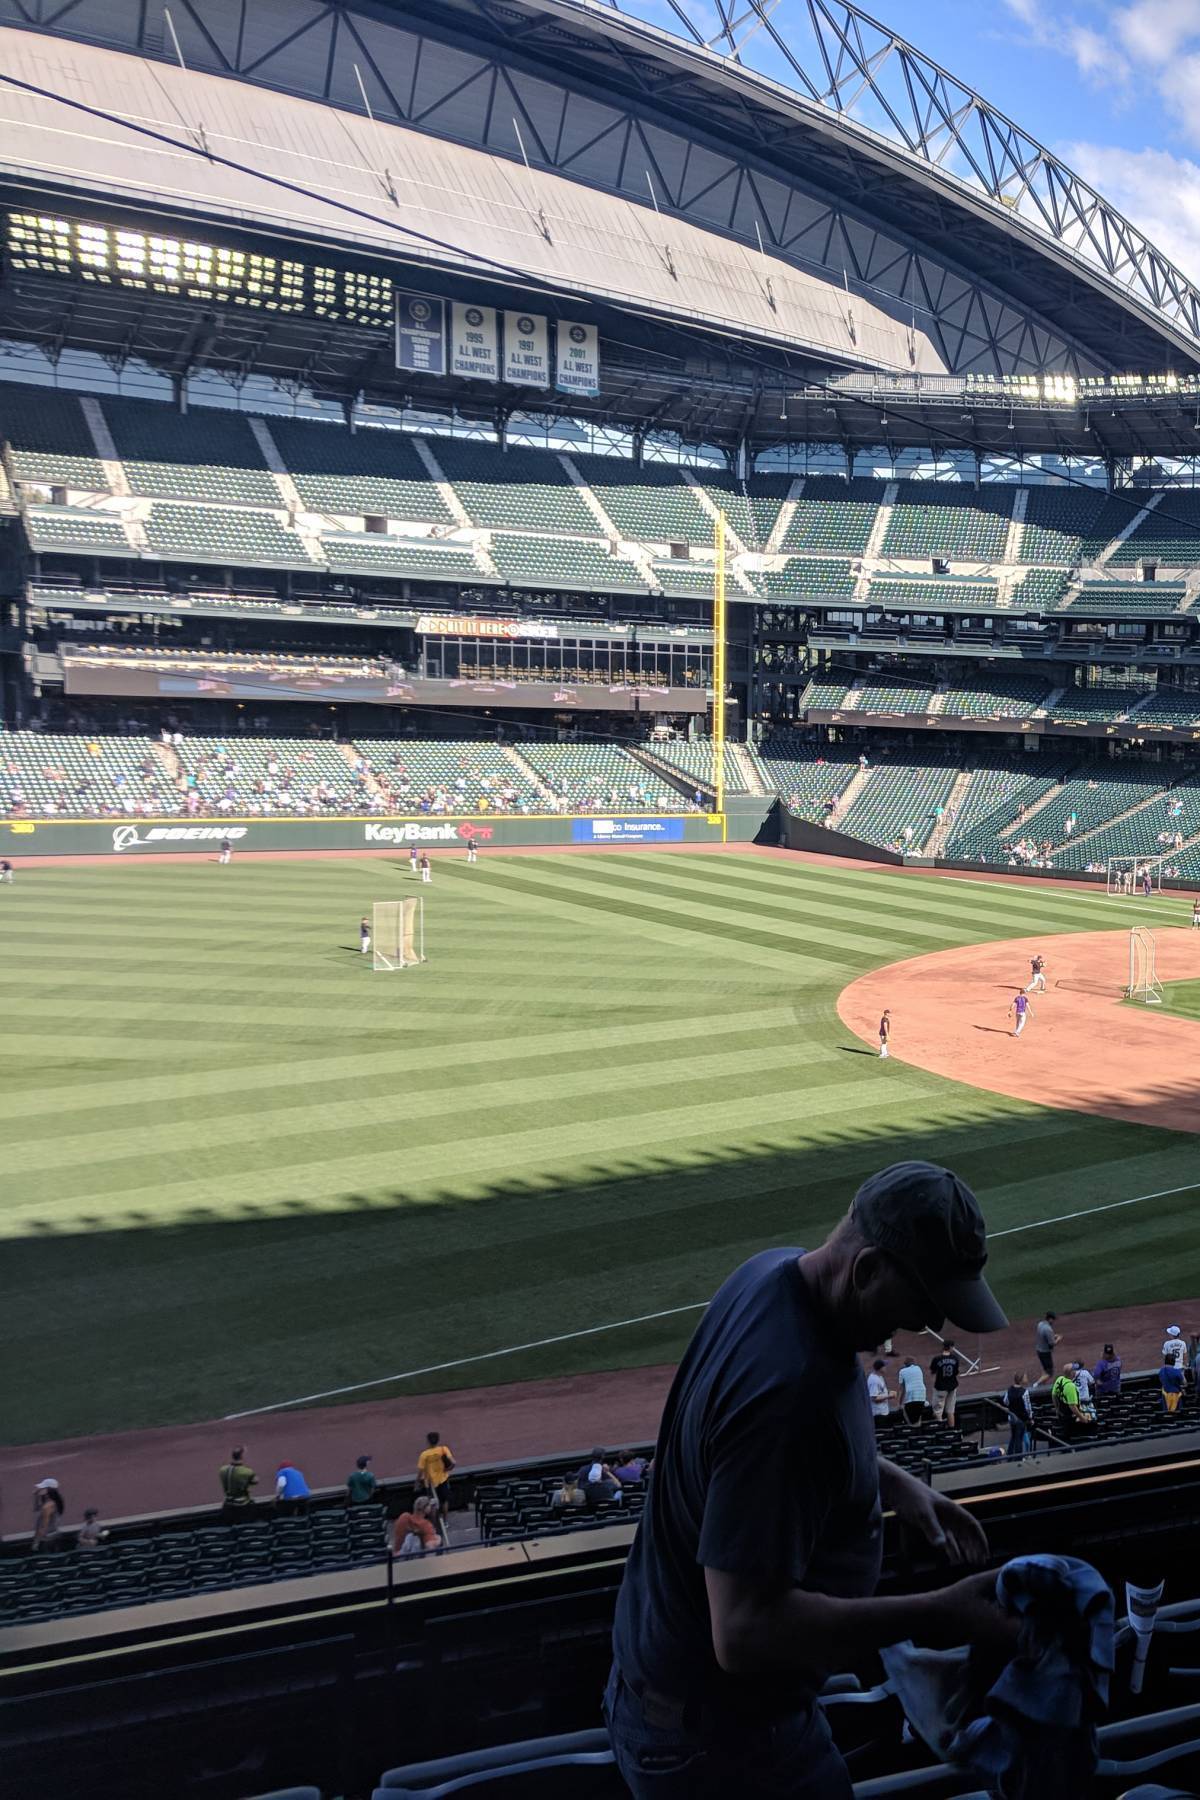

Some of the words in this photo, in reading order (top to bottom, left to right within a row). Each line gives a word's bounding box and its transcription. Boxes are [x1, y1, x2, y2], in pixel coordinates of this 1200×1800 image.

[472, 347, 491, 359] WEST
[455, 359, 495, 375] CHAMPIONS
[523, 354, 542, 367] WEST
[575, 361, 592, 374] WEST
[506, 367, 547, 382] CHAMPIONS
[559, 374, 596, 389] CHAMPIONS
[145, 827, 248, 839] BOEING
[365, 823, 458, 843] KeyBank
